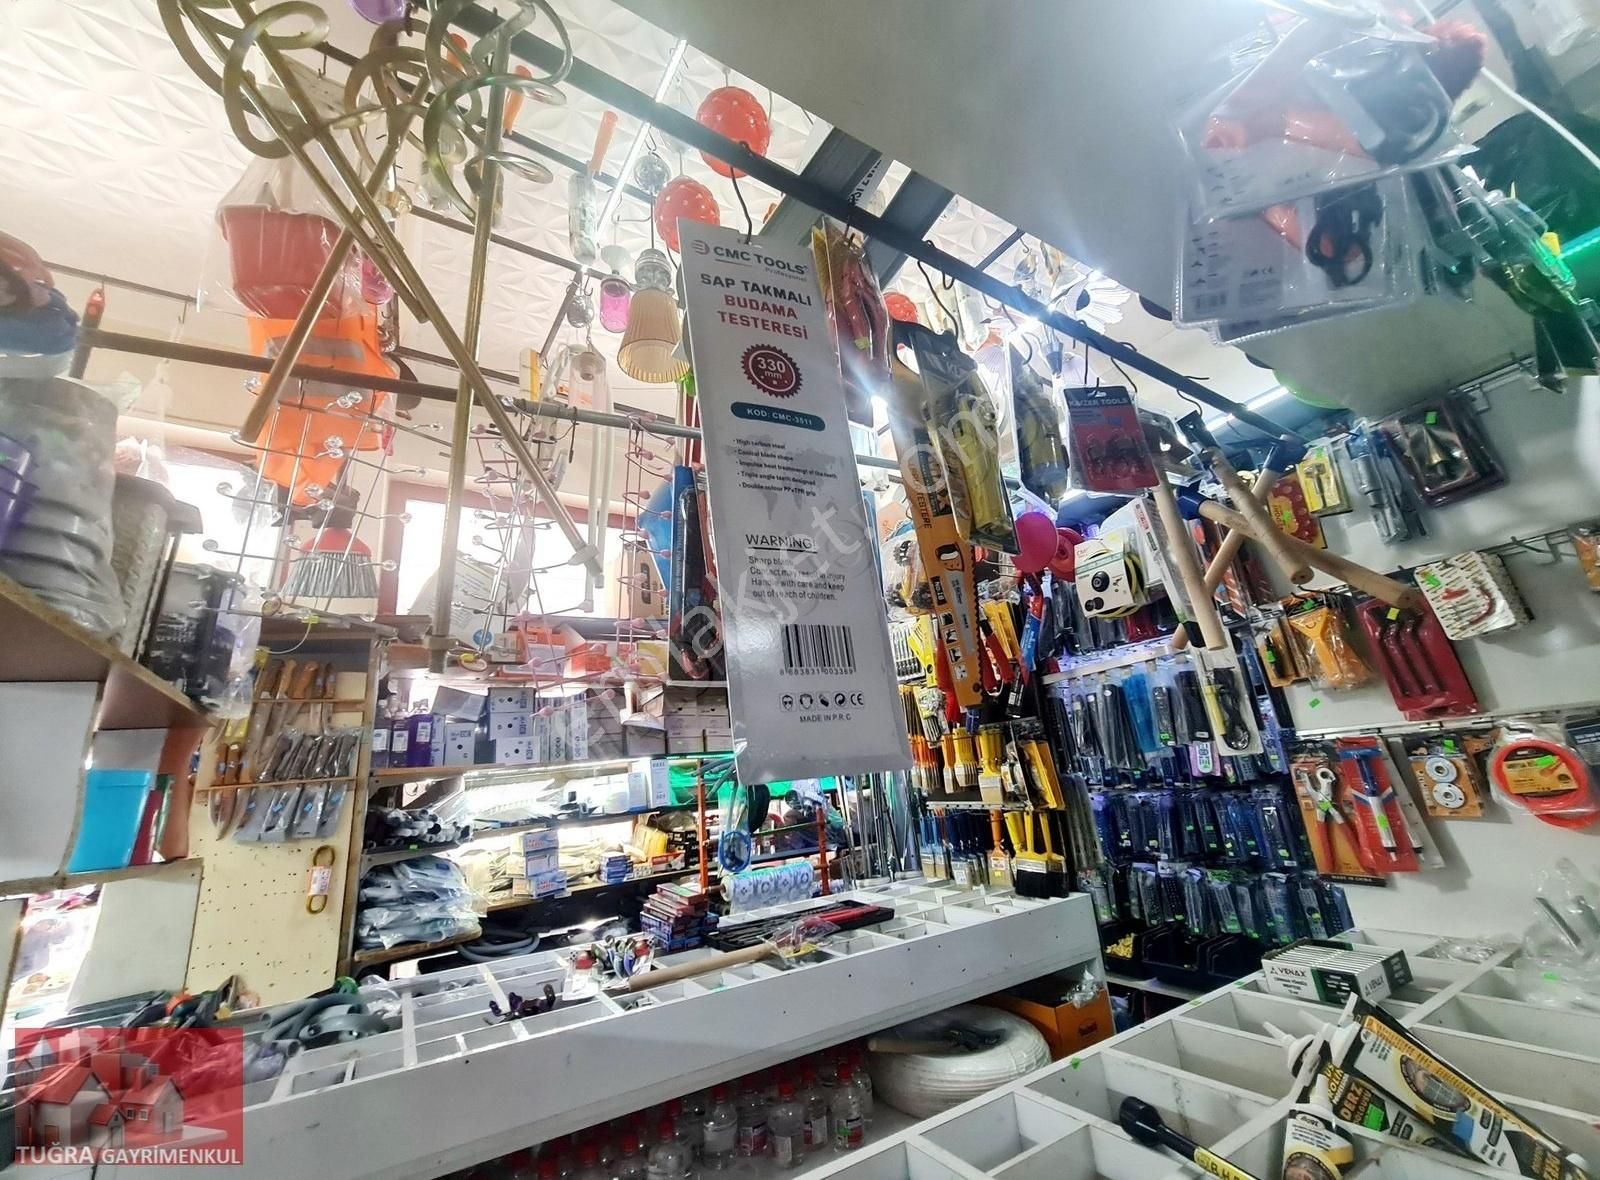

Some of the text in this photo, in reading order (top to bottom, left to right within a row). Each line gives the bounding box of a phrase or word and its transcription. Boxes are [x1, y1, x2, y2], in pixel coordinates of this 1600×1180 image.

[713, 246, 806, 275] CMC TOOLS
[700, 273, 812, 306] SAP TAKMALI
[724, 294, 798, 320] BUDAMA
[717, 310, 809, 339] TESTERESİ
[757, 357, 786, 373] 330
[764, 370, 782, 379] mm
[746, 408, 813, 425] KOD: CMC-3511
[745, 533, 817, 549] WARNING!
[780, 578, 797, 588] with
[797, 580, 814, 590] care
[814, 581, 828, 590] and
[799, 715, 822, 723] MADE
[1339, 1082, 1365, 1122] DERZ
